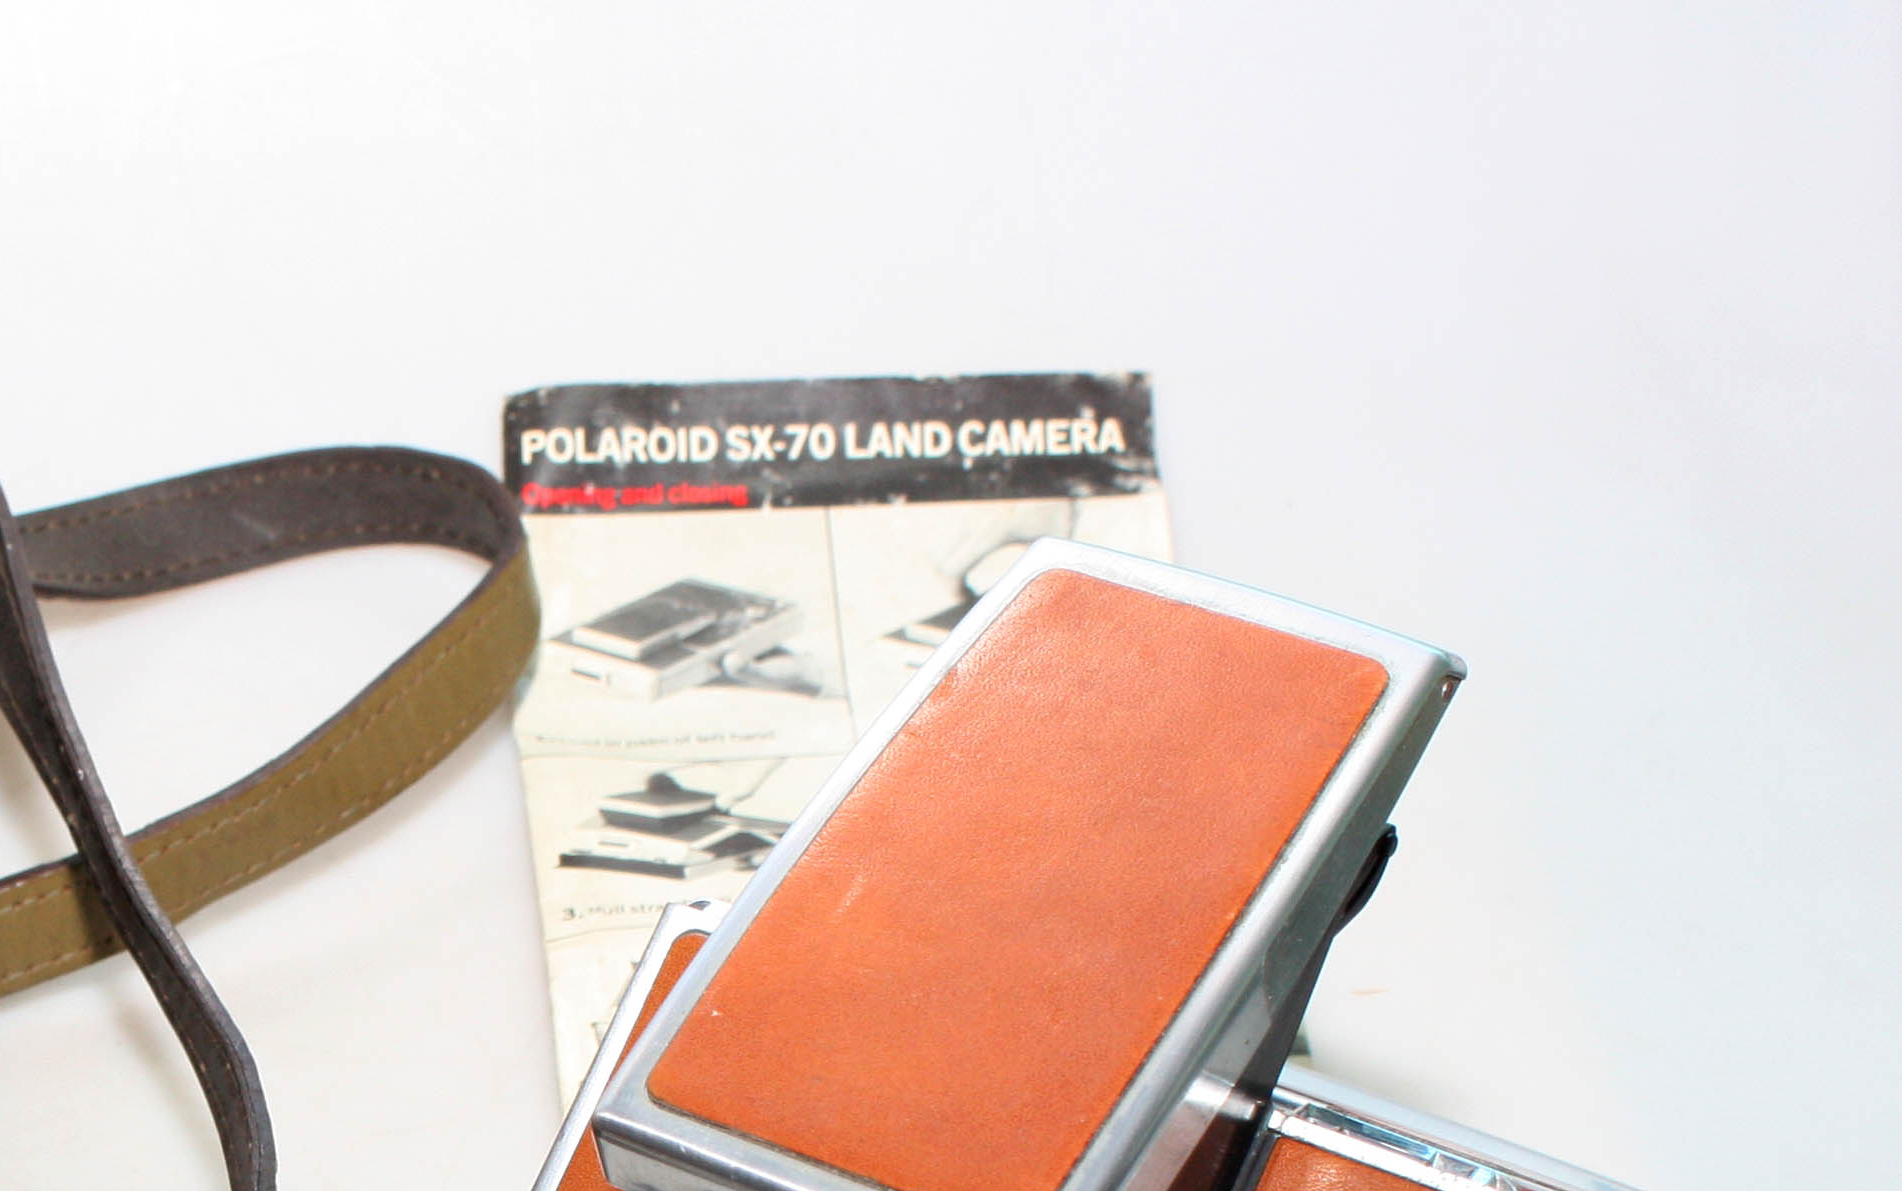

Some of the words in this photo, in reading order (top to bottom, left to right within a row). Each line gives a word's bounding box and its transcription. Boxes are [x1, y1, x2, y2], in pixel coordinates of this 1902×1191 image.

[520, 425, 718, 465] POLAROID
[724, 422, 836, 462] SX-70
[843, 420, 953, 459] LAND
[957, 417, 1126, 457] CAMERA
[621, 482, 664, 505] and
[667, 482, 748, 507] closing
